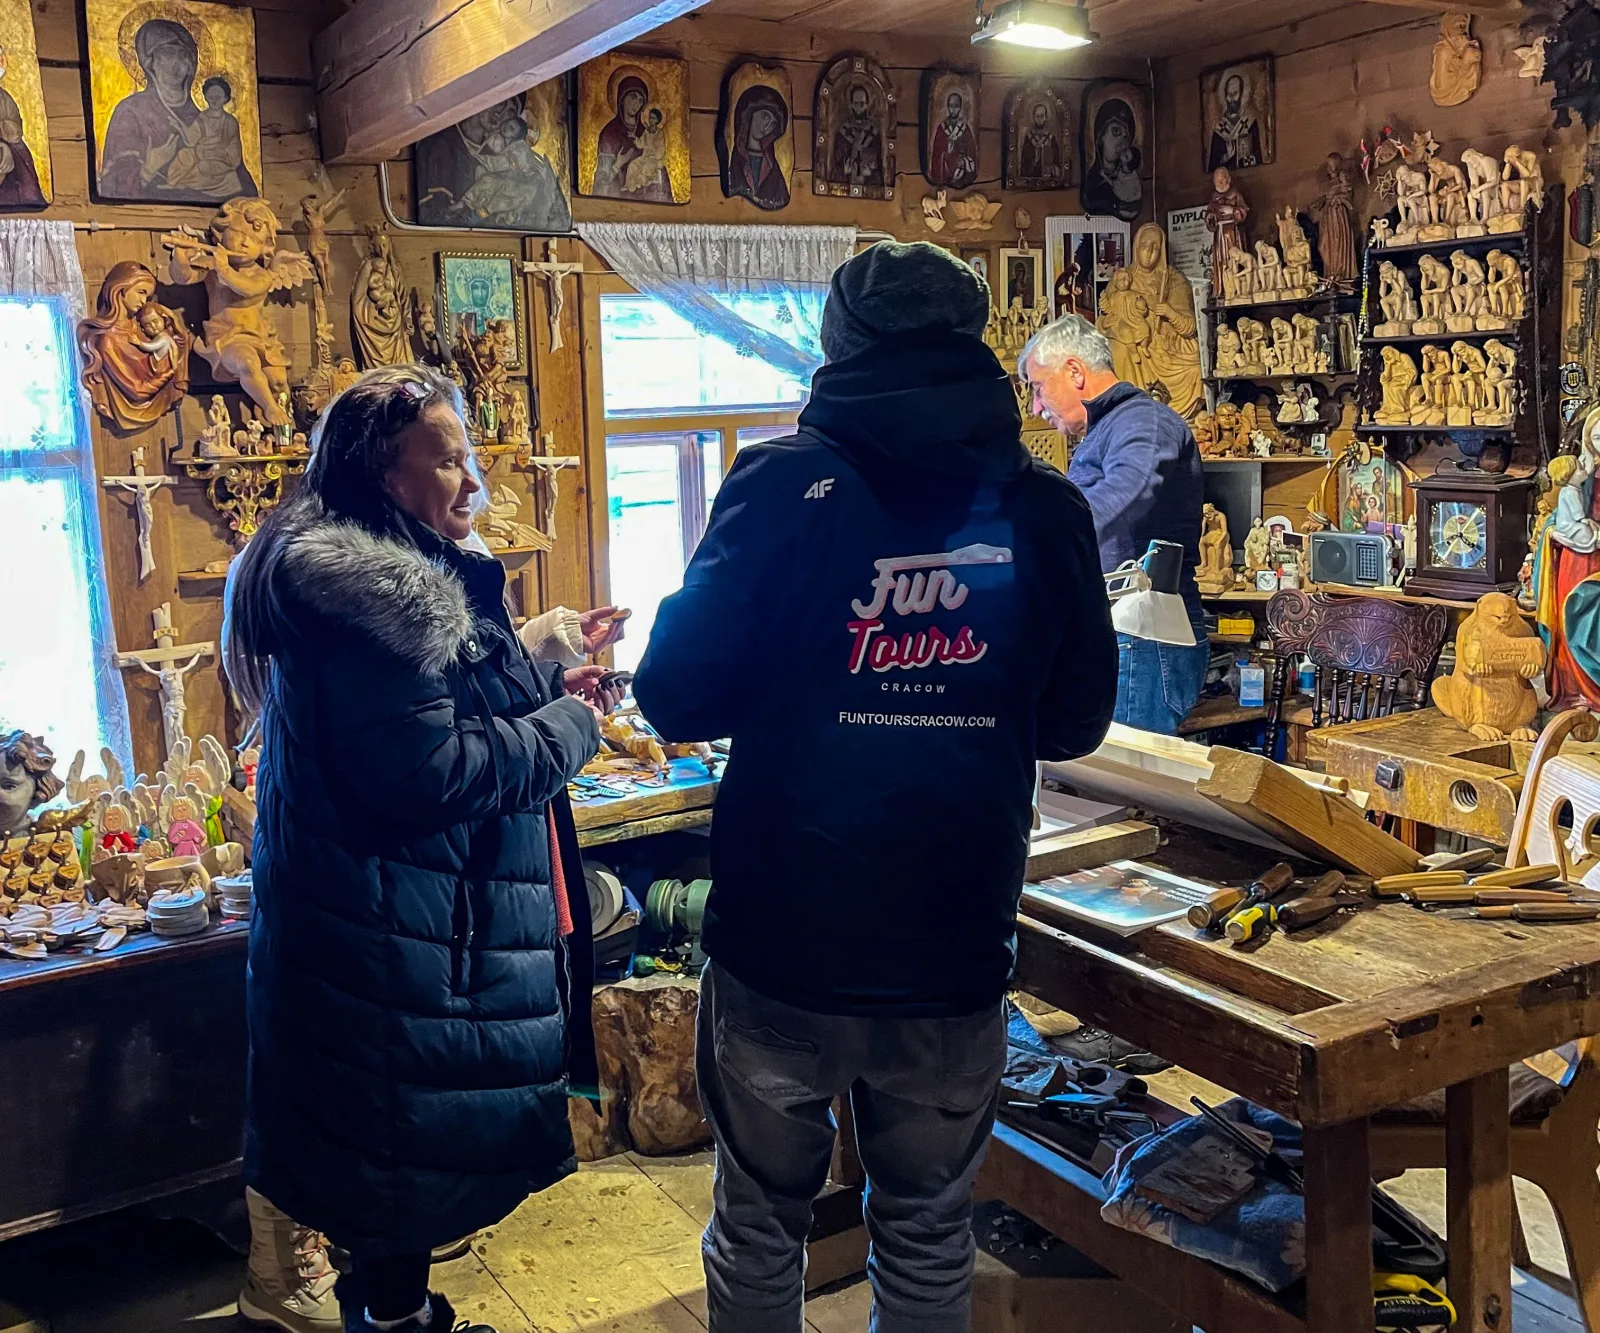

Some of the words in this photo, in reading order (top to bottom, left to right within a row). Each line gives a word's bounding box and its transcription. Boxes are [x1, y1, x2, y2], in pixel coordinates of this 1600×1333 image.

[1172, 210, 1206, 225] DYPLO
[851, 545, 1005, 619] Fun
[847, 619, 988, 674] Tours
[881, 683, 945, 693] CRACOW
[839, 711, 996, 728] FUNTOURSCRACOW.COM
